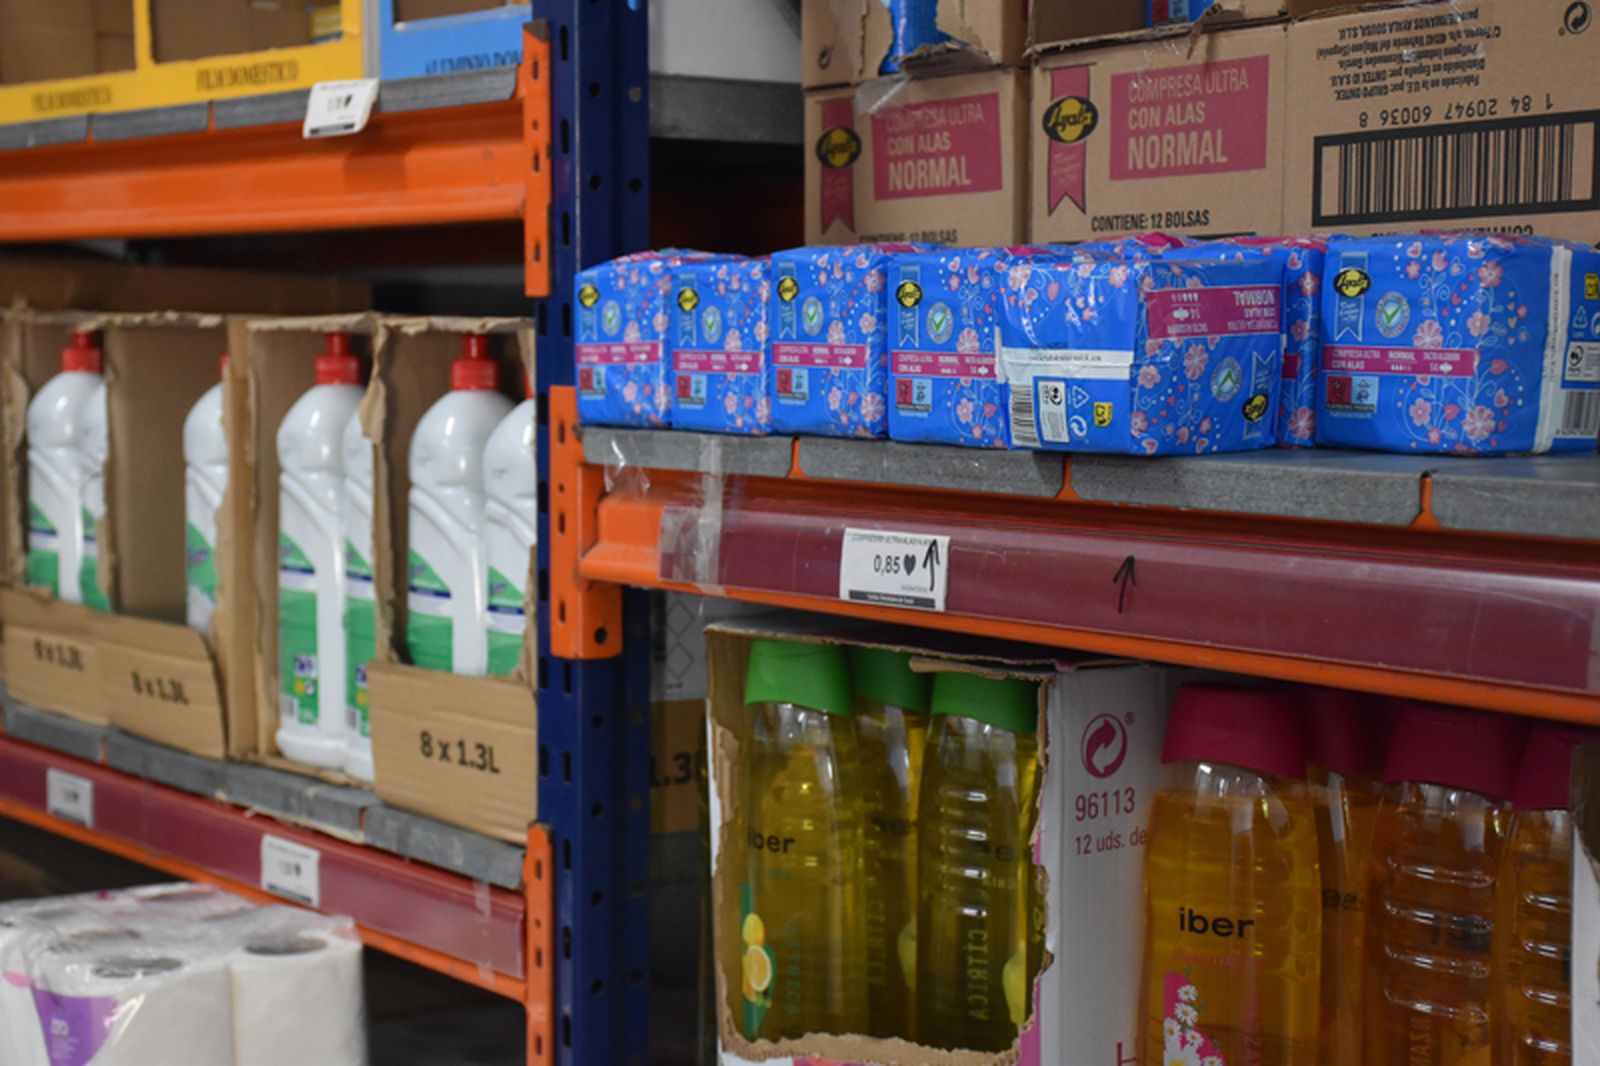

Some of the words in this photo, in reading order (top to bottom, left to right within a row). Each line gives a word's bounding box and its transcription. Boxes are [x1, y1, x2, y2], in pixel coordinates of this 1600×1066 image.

[1128, 75, 1205, 104] COMPRESA
[1206, 68, 1249, 94] ULTRA
[1443, 98, 1498, 121] 20947
[1510, 95, 1532, 113] 84
[1545, 93, 1553, 110] 1
[949, 103, 985, 127] ULTRA
[1128, 107, 1161, 131] CON
[1165, 101, 1206, 126] ALAS
[1358, 111, 1369, 128] 8
[1379, 105, 1433, 127] 60036
[887, 136, 915, 156] CON
[918, 131, 952, 152] ALAS
[1127, 129, 1228, 171] NORMAL
[888, 155, 971, 191] NORMAL
[1091, 214, 1148, 232] CONTIENE:
[1151, 213, 1163, 228] 12
[1165, 209, 1210, 227] BOLSAS
[921, 229, 958, 243] BOLSAS
[873, 554, 901, 577] 0,85
[419, 729, 434, 759] 8
[437, 740, 451, 763] x
[457, 739, 501, 775] 1.3L
[1074, 786, 1136, 822] 96113
[1075, 833, 1093, 855] 12
[1095, 829, 1126, 853] uds.
[1178, 906, 1256, 938] iber
